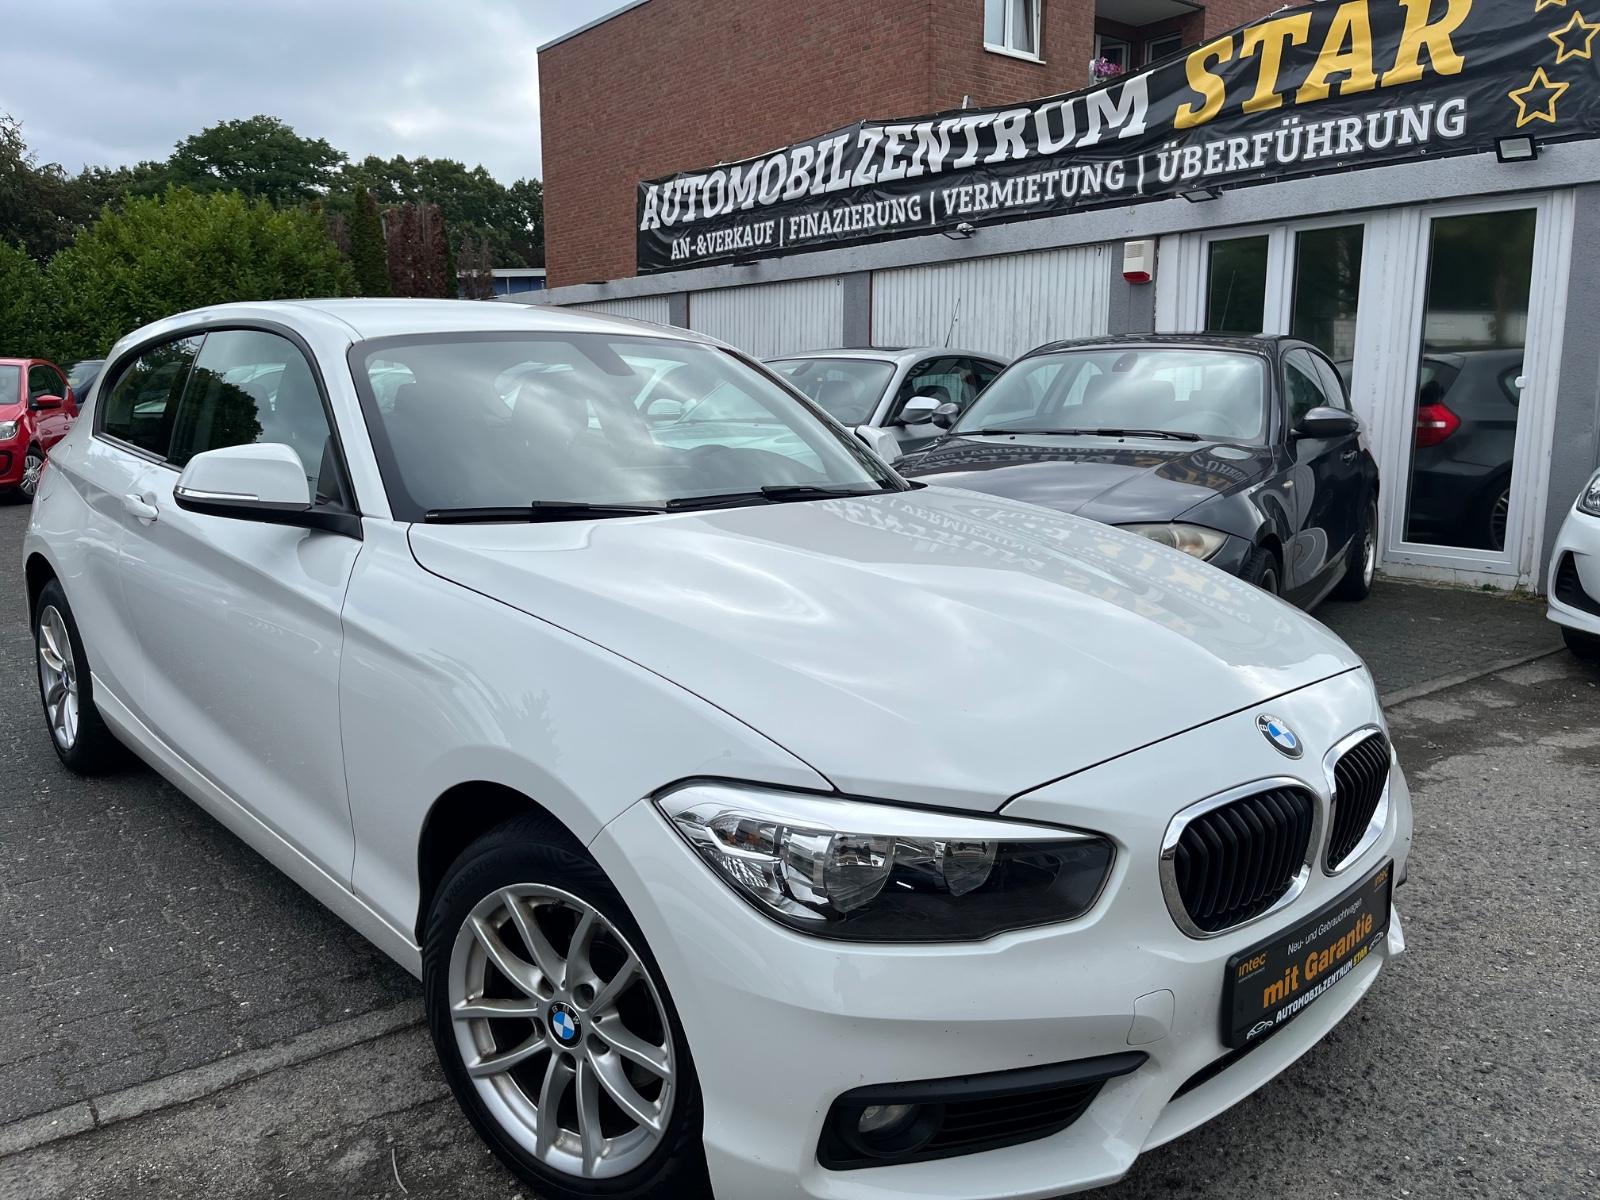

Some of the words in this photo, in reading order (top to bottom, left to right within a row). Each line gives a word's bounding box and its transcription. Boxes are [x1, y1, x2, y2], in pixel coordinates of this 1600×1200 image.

[640, 69, 1156, 231] AUTOMOBILZENTRUM
[1173, 0, 1473, 129] STAR
[789, 195, 922, 240] FINAZIERUNG
[942, 159, 1126, 215] VERMIETUNG
[1157, 98, 1466, 183] ÜBERFÜHRUNG
[1263, 964, 1299, 1009] mit
[1304, 912, 1373, 982] Garantie
[1305, 928, 1318, 944] und
[551, 1004, 580, 1025] BMW
[1275, 958, 1353, 1024] AUTOMOBILZENTRUM
